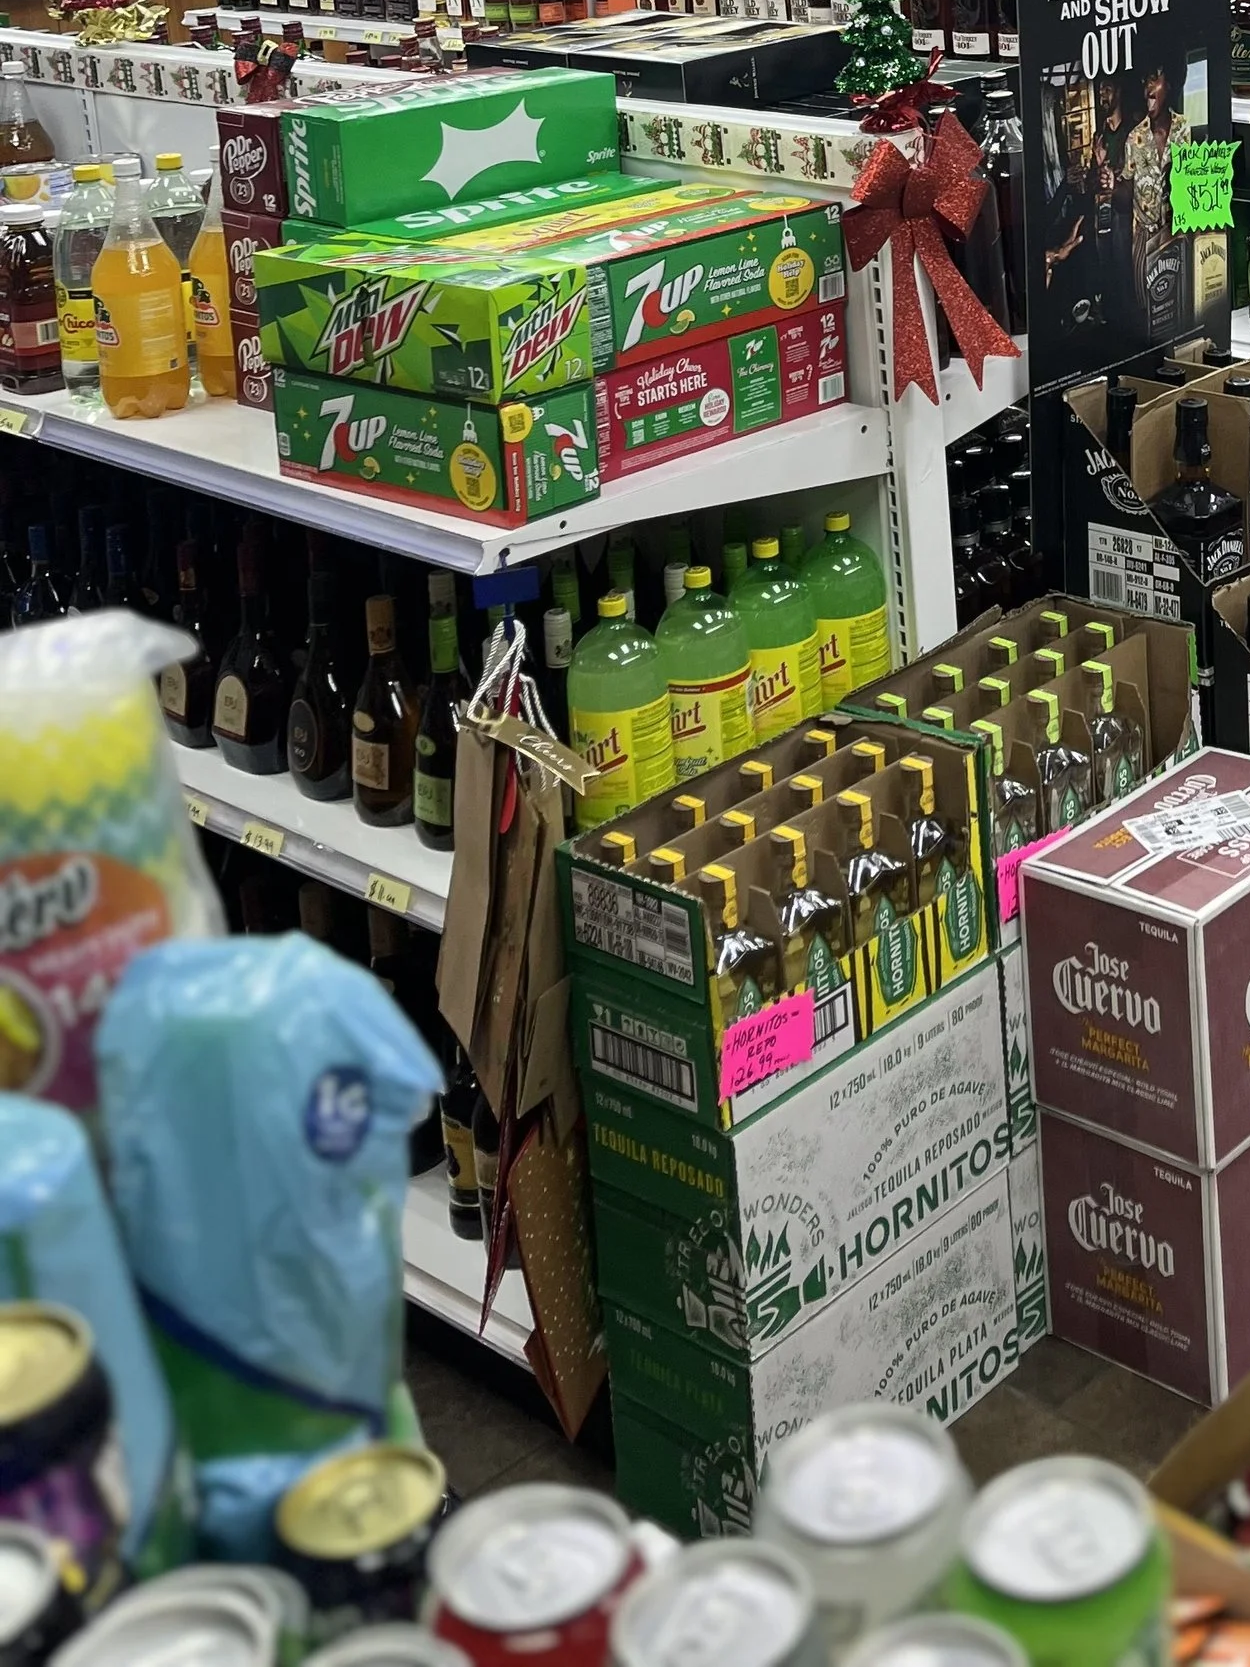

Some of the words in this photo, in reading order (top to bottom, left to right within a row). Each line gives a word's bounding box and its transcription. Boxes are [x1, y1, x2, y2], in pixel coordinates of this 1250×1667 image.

[1082, 22, 1137, 80] OUT
[285, 117, 317, 218] Sprite
[586, 145, 617, 164] Sprite
[262, 193, 276, 208] 12
[401, 179, 599, 231] Sprite
[823, 206, 840, 220] 12
[703, 274, 742, 293] Flavored
[744, 268, 766, 284] Soda
[708, 263, 737, 279] Lemon
[738, 257, 759, 272] Lime
[622, 258, 704, 352] 7UP
[469, 367, 485, 388] 12
[637, 364, 675, 389] Holiday
[637, 381, 676, 406] STARTS
[680, 373, 708, 394] HERE
[1139, 921, 1179, 943] TEQUILA
[1084, 942, 1130, 981] Jose
[952, 1007, 964, 1024] 80
[1052, 956, 1161, 1034] Cuervo
[862, 1140, 894, 1182] 100%
[894, 1099, 927, 1135] PURO
[928, 1087, 947, 1105] DE
[947, 1082, 986, 1099] AGAVE
[593, 1123, 648, 1165] TEQUILA
[651, 1150, 725, 1198] REPOSADO
[873, 1161, 922, 1200] TEQUILA
[923, 1112, 981, 1168] REPOSADO
[839, 1121, 1012, 1280] HORNITOS
[1153, 1167, 1192, 1192] TEQUILA
[743, 1192, 825, 1247] WONDERS
[1100, 1183, 1144, 1223] Jose
[1068, 1195, 1175, 1277] Cuervo
[874, 1353, 904, 1399] 100%
[904, 1317, 938, 1354] PURO
[939, 1303, 956, 1322] DE
[957, 1290, 995, 1311] AGAVE
[949, 1322, 989, 1367] PLATA
